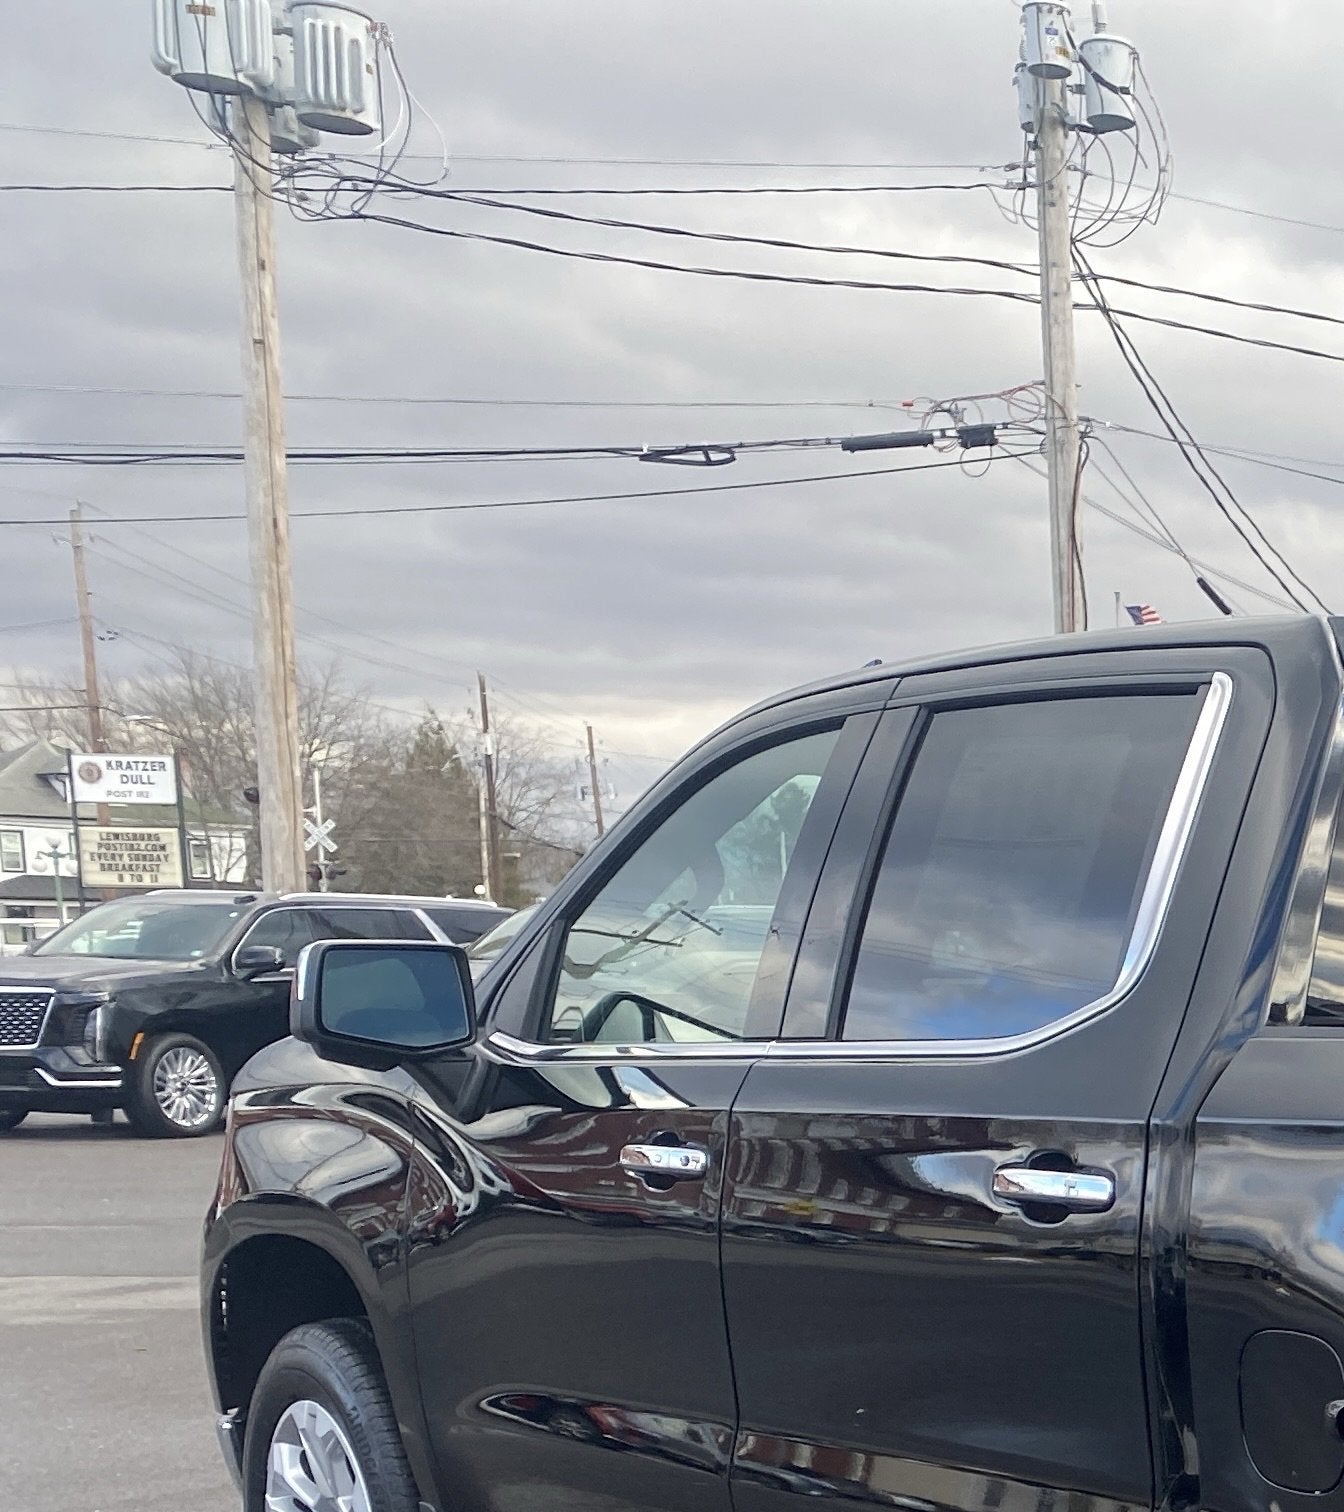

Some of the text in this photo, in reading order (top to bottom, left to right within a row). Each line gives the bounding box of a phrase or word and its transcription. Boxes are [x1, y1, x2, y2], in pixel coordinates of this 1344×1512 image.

[105, 760, 167, 772] KRATZER
[120, 774, 156, 785] DULL
[106, 790, 132, 798] POST
[100, 832, 161, 842] LEWISBURG
[89, 852, 170, 863] EVERY SUNDAY
[100, 863, 161, 873] BREAKFAST
[130, 874, 143, 883] TO
